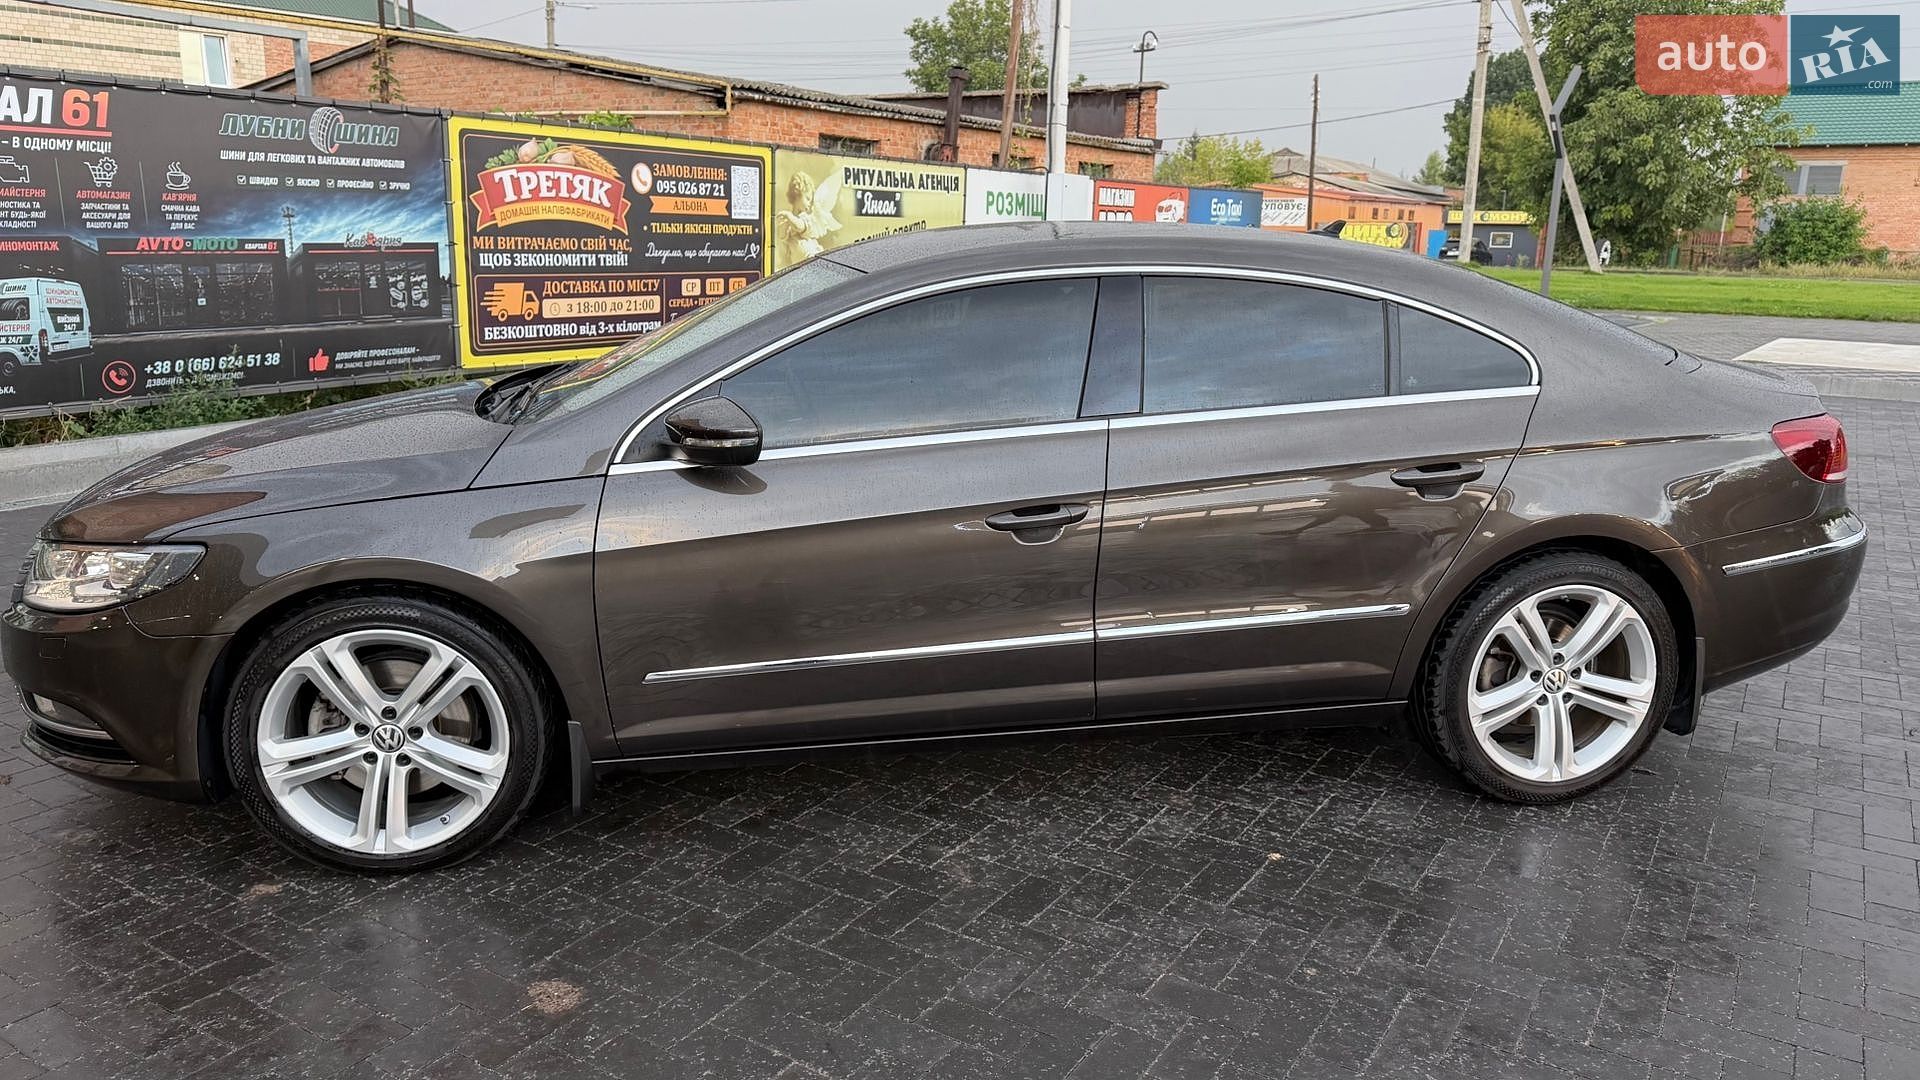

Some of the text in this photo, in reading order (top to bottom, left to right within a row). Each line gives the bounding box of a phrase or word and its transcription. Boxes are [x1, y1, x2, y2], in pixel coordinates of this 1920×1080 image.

[62, 88, 109, 128] 61
[218, 113, 399, 147] ЛУБНИ ШИНА
[12, 136, 20, 148] В
[23, 137, 73, 151] ОДНОМУ
[76, 140, 112, 154] МІСЦІ!
[220, 150, 246, 160] ШИНИ
[247, 151, 265, 162] ДЛЯ
[266, 152, 306, 164] ЛЕГКОВИХ
[307, 155, 316, 164] ТА
[317, 156, 361, 167] ВАНТАЖНИХ
[652, 163, 727, 181] ЗАМОВЛЕННЯ:
[844, 167, 960, 194] РИТУАЛЬНА АГЕНЦІЯ
[76, 190, 131, 200] АВТОМАГАЗИН
[656, 180, 725, 197] 095 026 87 21
[32, 201, 40, 209] ТА
[80, 202, 130, 211] ЗАПЧАСТИНИ ТА
[672, 201, 708, 212] АЛЬОНА
[1211, 198, 1243, 217] Eco Taxi
[1262, 202, 1306, 210] УПОВУЄ:
[10, 210, 46, 219] БУДЬ-ЯКОЇ
[81, 212, 117, 220] АКСЕСУАРИ
[500, 205, 610, 225] ДОМАШНІ НАПІВФАБРИКАТИ
[650, 222, 752, 236] ТІЛЬКИ ЯКІСНІ ПРОДУКТИ
[473, 235, 632, 252] МИ ВИТРАЧАЄМО СВІЙ ЧАС,
[479, 251, 628, 269] ЩОБ ЗЕКОНОМИТИ ТВІЙ!
[542, 279, 661, 296] ДОСТАВКА ПО МІСТУ
[686, 283, 697, 292] СР
[709, 282, 721, 291] ПТ
[577, 302, 607, 314] 18:00
[610, 301, 623, 313] до
[626, 299, 655, 311] 21:00
[669, 298, 693, 307] СЕРЕДА
[484, 323, 578, 340] БЕЗКОШТОВНО
[579, 322, 597, 336] від
[616, 320, 661, 334] кілограм
[144, 352, 280, 375] +38 0 (66) 624 51 38
